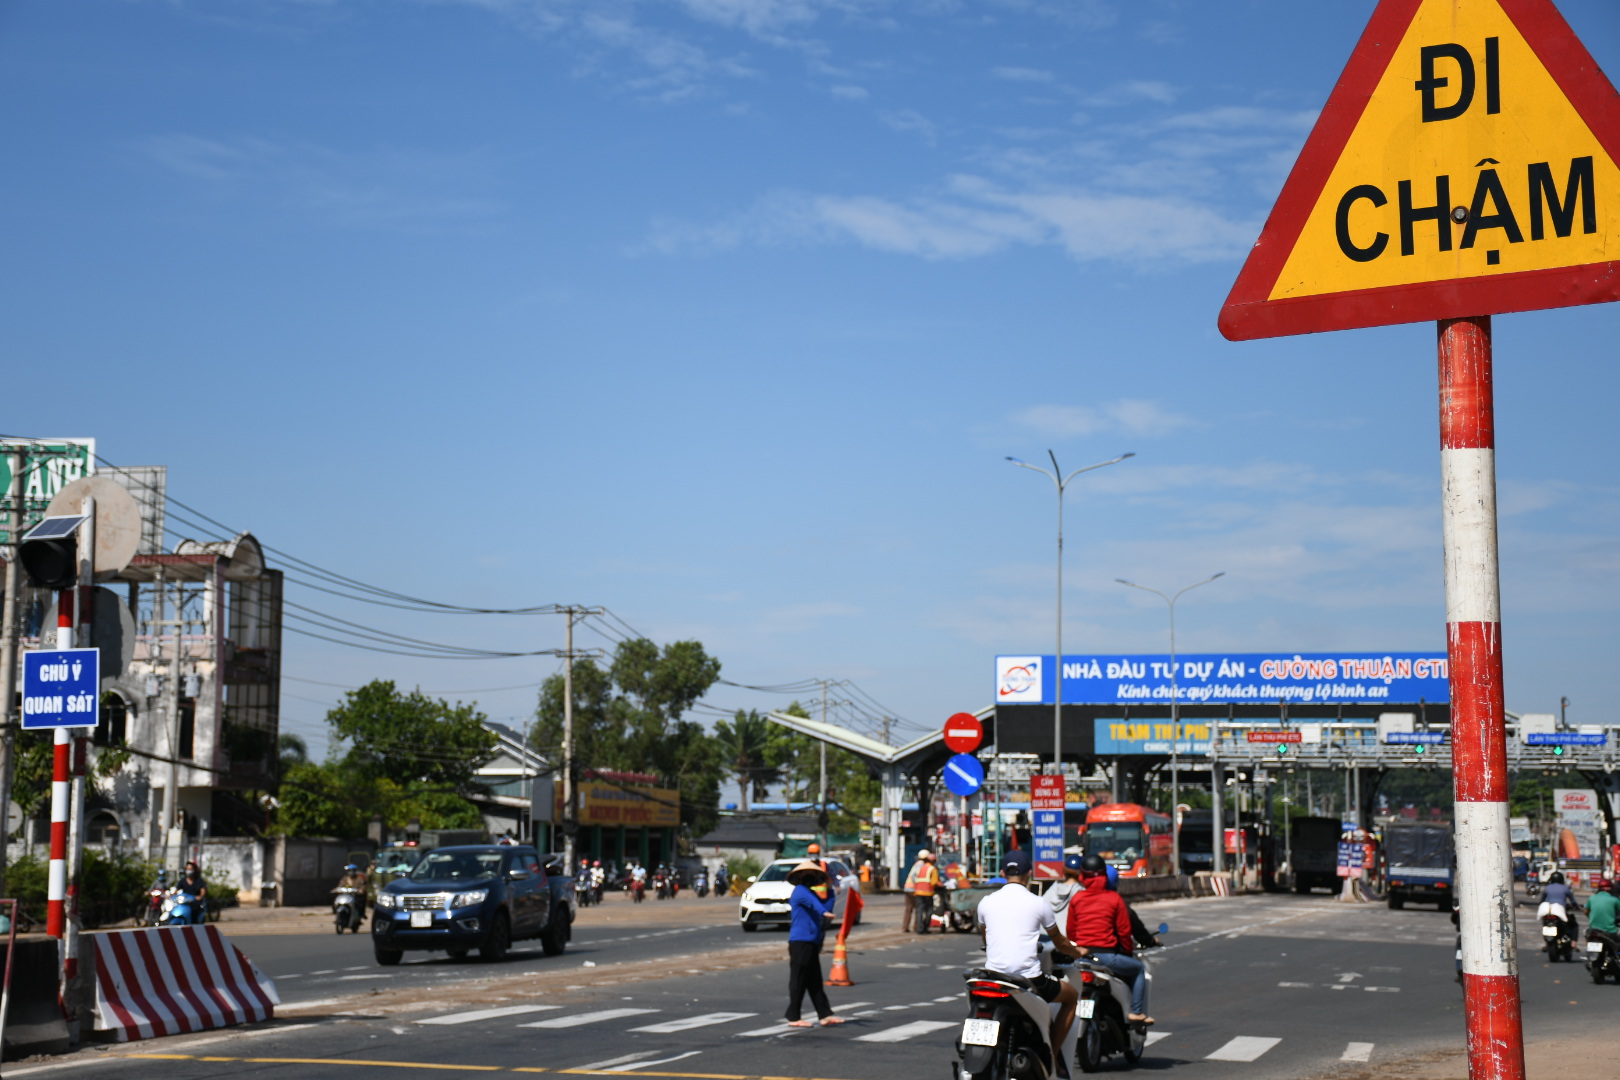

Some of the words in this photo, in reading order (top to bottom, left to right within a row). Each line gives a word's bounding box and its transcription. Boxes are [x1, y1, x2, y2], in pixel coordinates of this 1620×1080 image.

[1415, 36, 1500, 123] ĐI
[1335, 155, 1597, 266] CHẬM
[40, 659, 69, 682] CHÚ
[72, 659, 82, 681] Ý
[1062, 658, 1103, 679] NHÀ
[1106, 660, 1146, 679] ĐẦU
[1151, 662, 1179, 679] TƯ
[1184, 661, 1214, 682] DỰ
[1217, 658, 1245, 678] ÁN
[1260, 655, 1338, 680] CƯỜNG
[1339, 656, 1412, 684] THUẬN
[1413, 658, 1449, 679] CTI
[25, 695, 63, 715] QUAN
[66, 690, 94, 713] SÁT
[1117, 684, 1151, 699] Kính
[1152, 684, 1187, 699] chúc
[1188, 685, 1213, 701] quý
[1213, 684, 1258, 698] khách
[1260, 684, 1314, 701] thượng
[1315, 684, 1331, 700] lộ
[1332, 684, 1365, 698] bình
[1367, 686, 1389, 698] an
[1109, 723, 1150, 742] TRẠM
